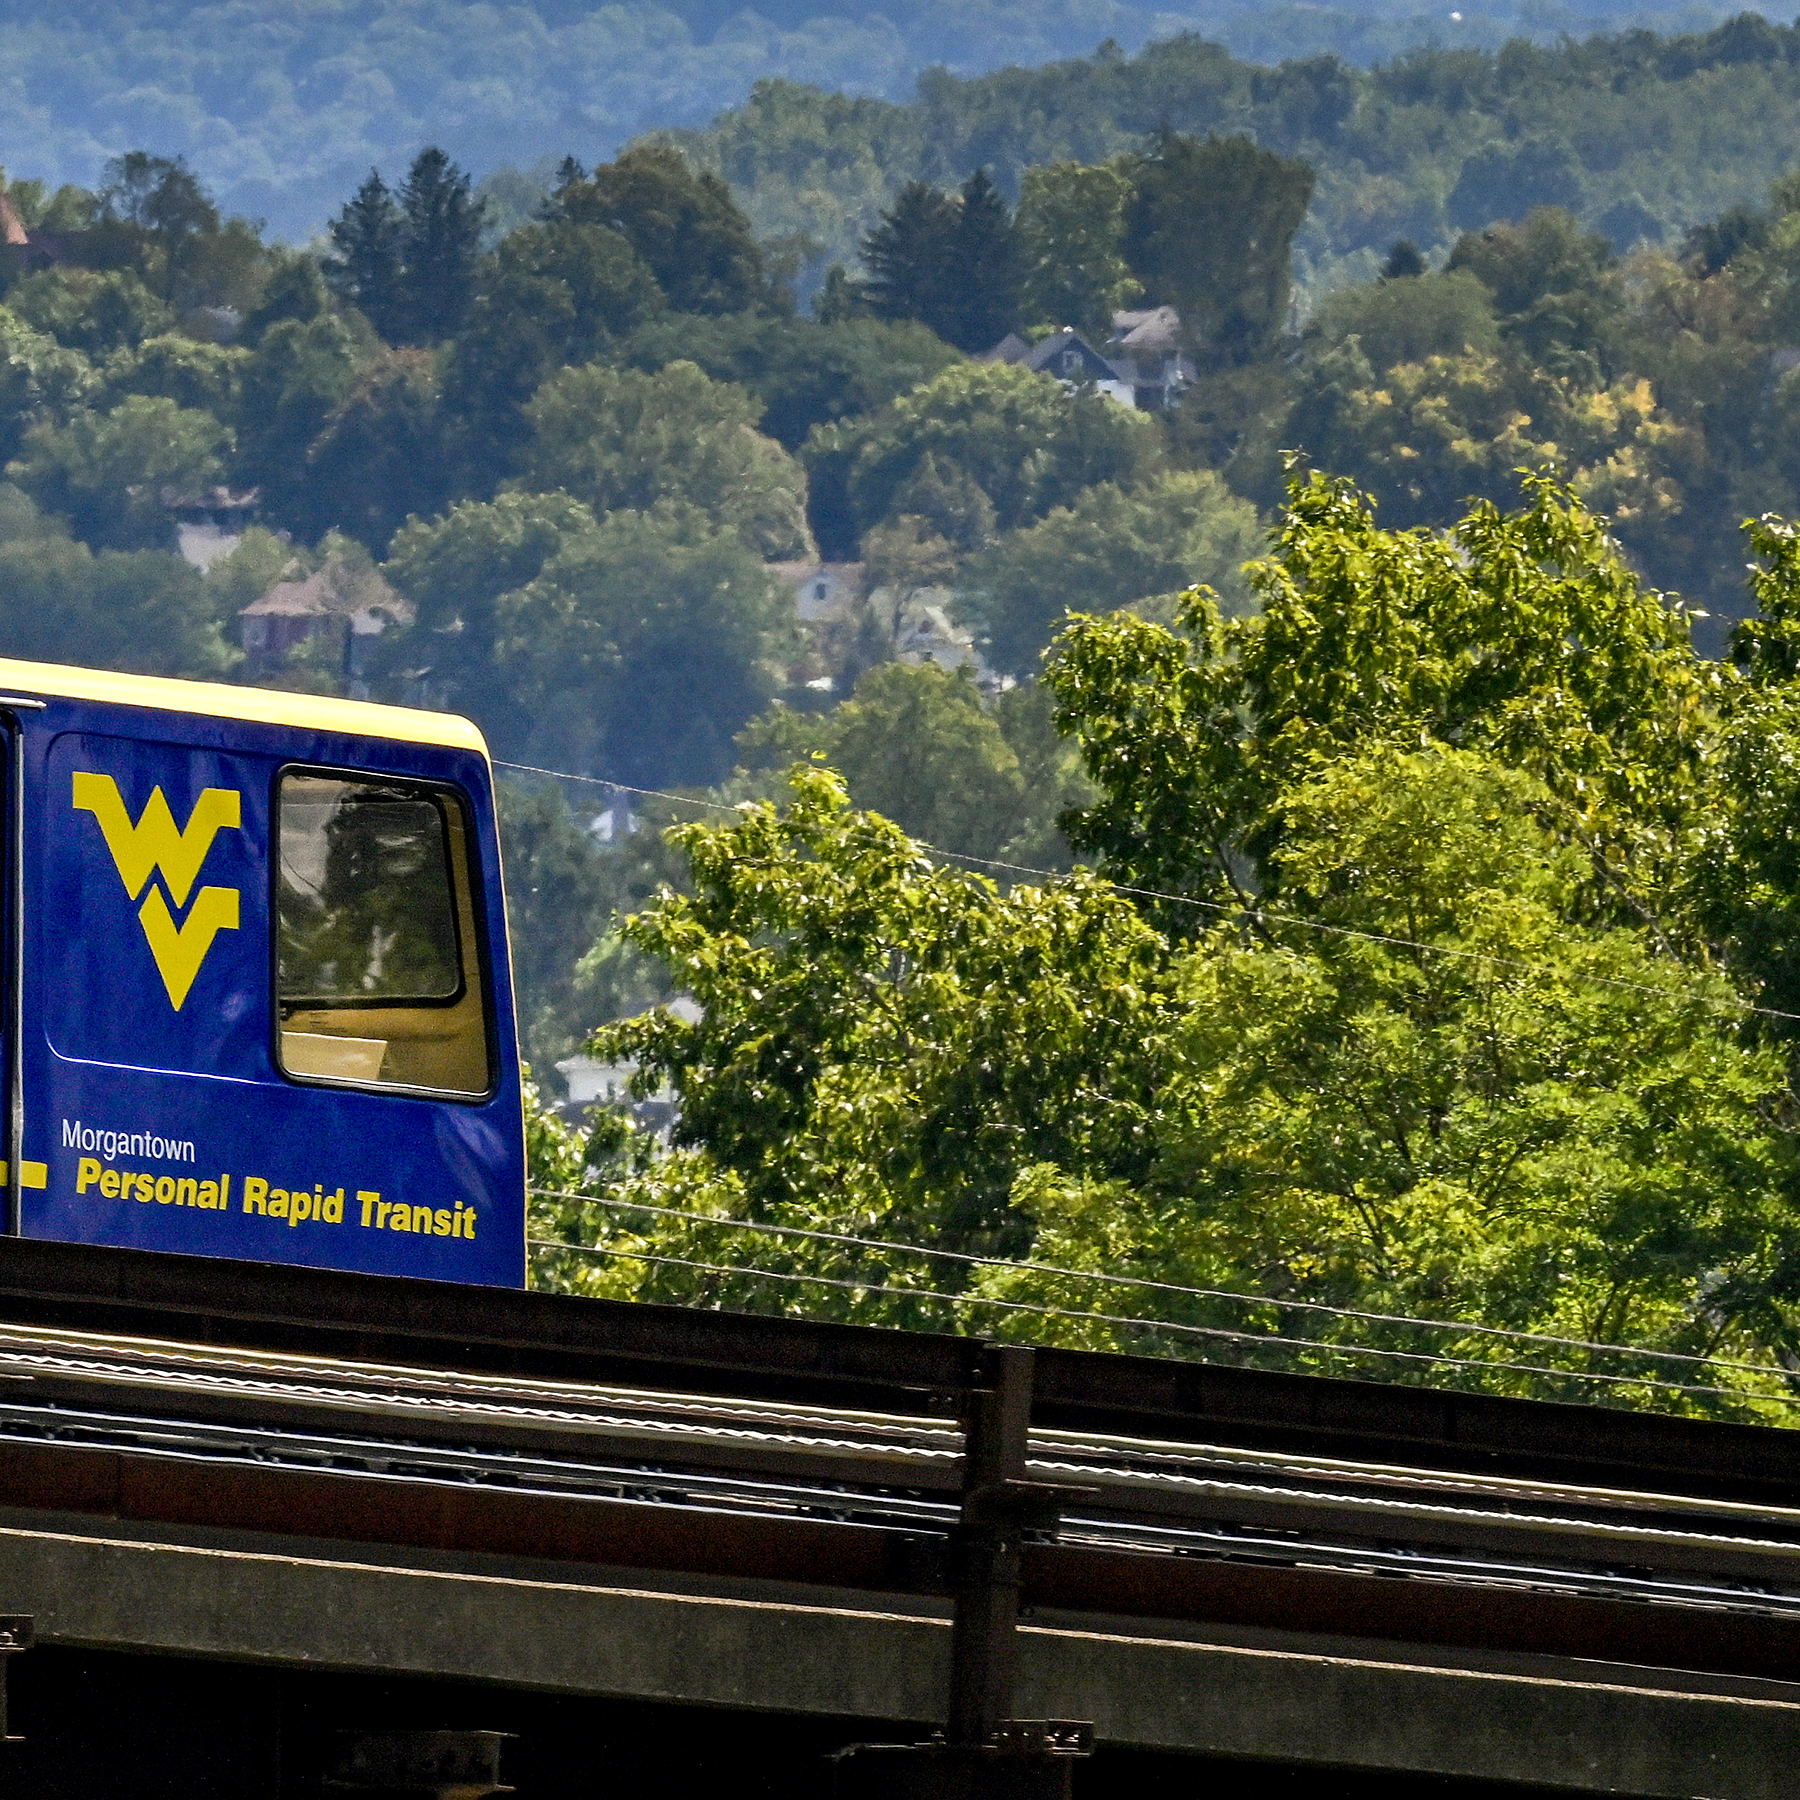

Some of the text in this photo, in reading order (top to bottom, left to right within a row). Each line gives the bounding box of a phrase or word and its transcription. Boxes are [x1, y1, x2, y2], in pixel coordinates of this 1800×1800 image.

[62, 1119, 195, 1162] Morgantown
[77, 1157, 477, 1240] Personal Rapid Transit
